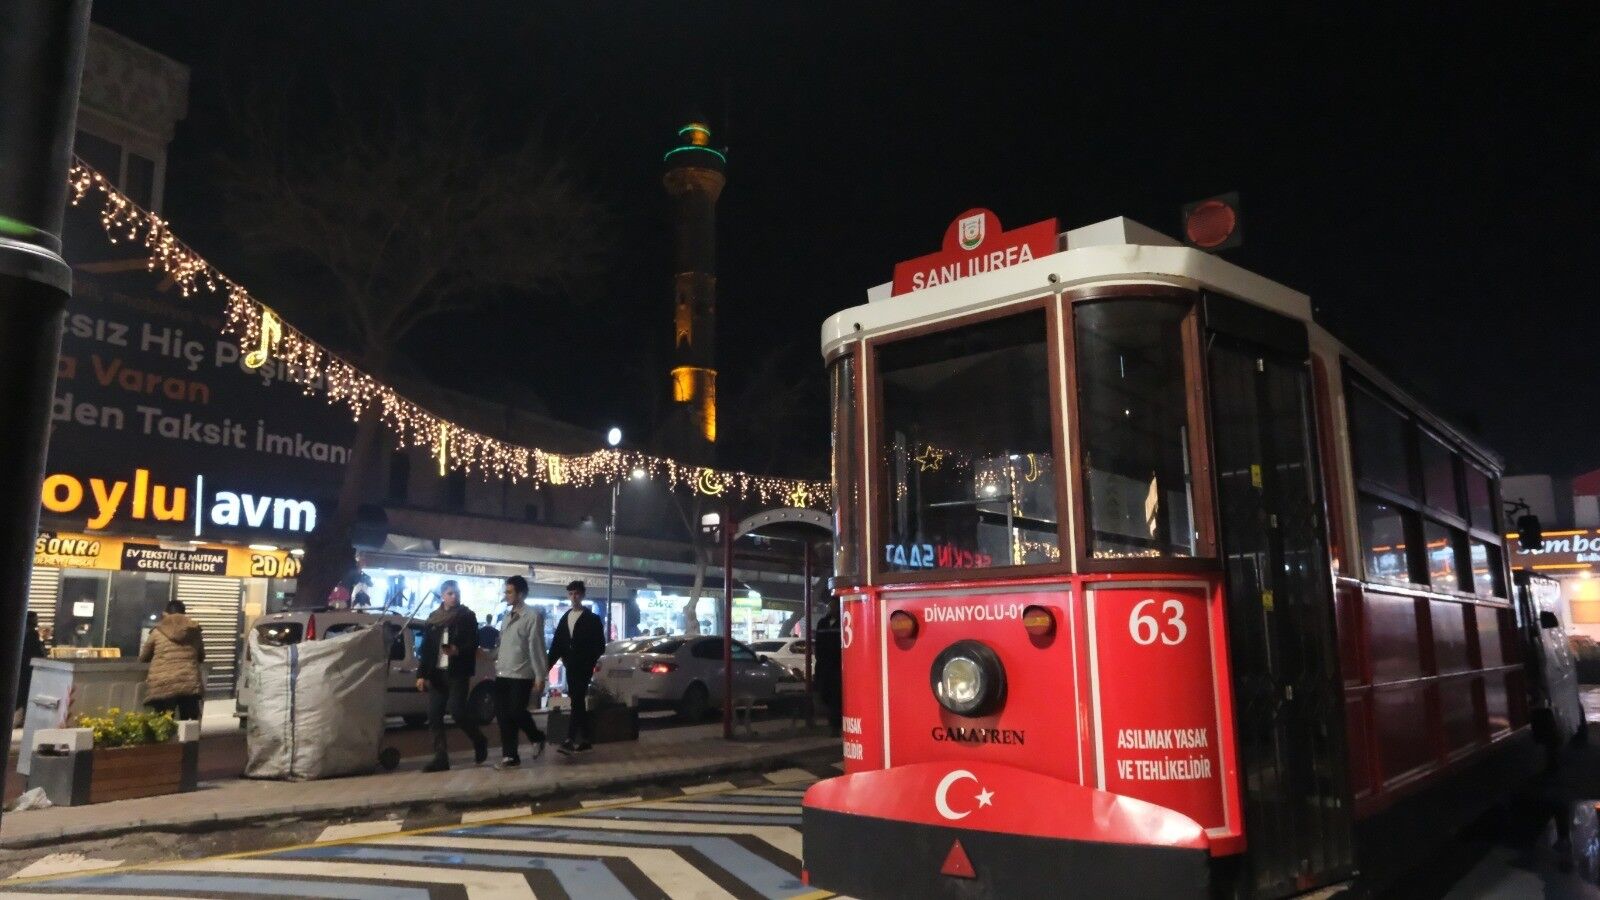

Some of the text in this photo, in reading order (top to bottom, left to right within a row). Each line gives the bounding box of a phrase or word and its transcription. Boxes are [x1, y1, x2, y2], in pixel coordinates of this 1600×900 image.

[141, 322, 204, 371] Hiç
[91, 353, 210, 405] Varan
[136, 404, 247, 449] Taksit
[211, 490, 317, 532] avm
[35, 538, 101, 557] SONRA
[126, 548, 139, 558] EV
[188, 552, 224, 564] MUTFAK
[137, 558, 215, 573] GEREÇLERİNDE
[419, 561, 451, 573] EROL
[1129, 599, 1187, 646] 63
[931, 727, 1025, 746] GARATREN
[1117, 727, 1208, 750] ASILMAK YASAK
[1117, 754, 1211, 781] VE TEHLİKELİDİR
